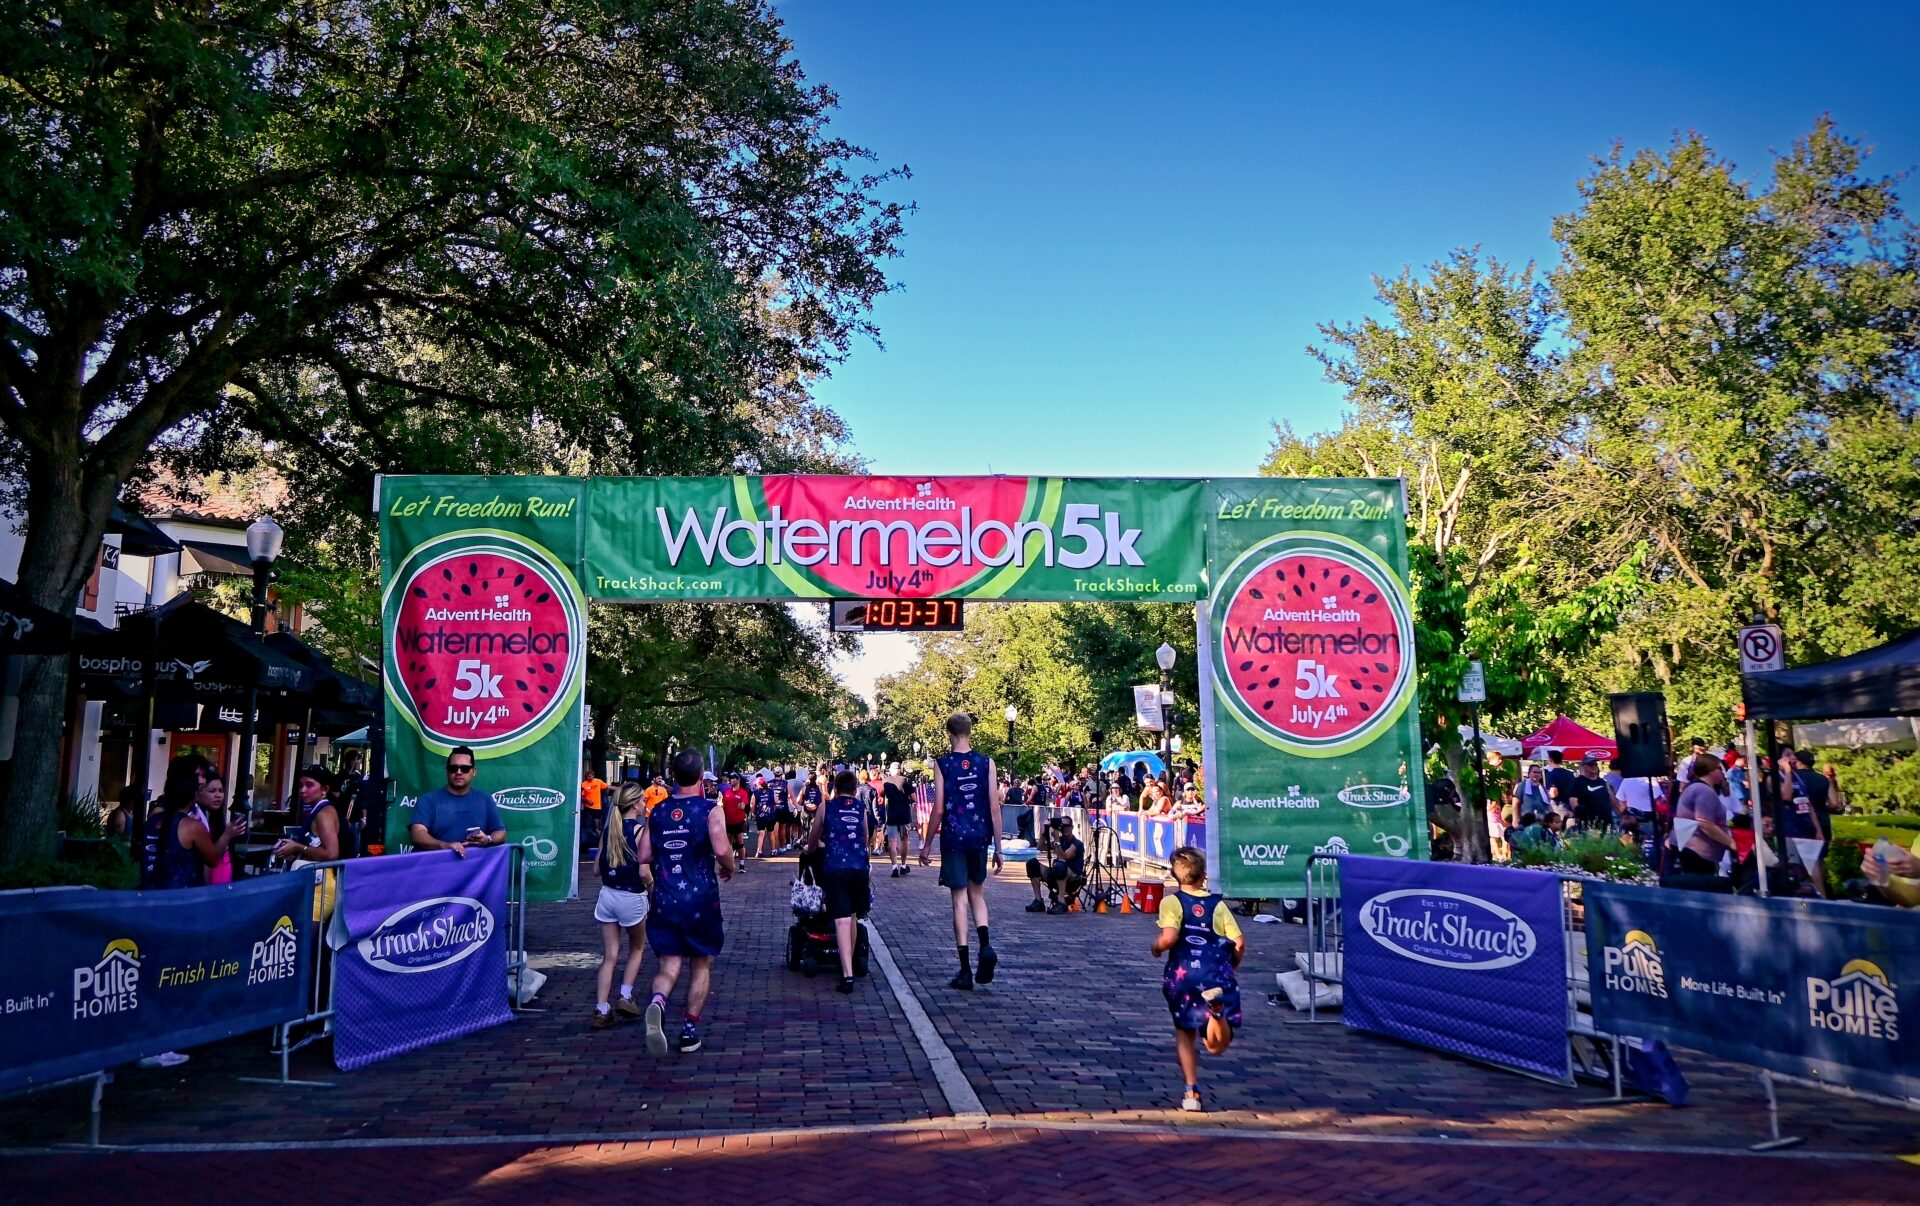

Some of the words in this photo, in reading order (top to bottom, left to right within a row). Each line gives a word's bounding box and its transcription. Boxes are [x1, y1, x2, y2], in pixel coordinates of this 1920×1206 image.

[390, 495, 431, 517] Let
[433, 495, 522, 518] Freedom
[525, 496, 576, 518] Run!
[1218, 497, 1258, 520] Let
[1260, 497, 1344, 520] Freedom
[1348, 499, 1391, 520] Run!
[597, 576, 722, 591] TrackShack.com
[865, 570, 906, 594] July
[906, 570, 934, 589] 4th
[1074, 578, 1198, 594] TrackShack.com
[398, 626, 570, 655] Watermelon
[1225, 626, 1400, 655] Watermelon
[452, 659, 504, 700] 5k
[1295, 659, 1341, 700] 5k
[443, 705, 483, 730] July
[484, 705, 510, 724] 4th
[1289, 704, 1324, 729] July
[1324, 705, 1348, 723] 4th
[495, 793, 527, 804] Track
[527, 792, 562, 804] Shack
[1344, 791, 1372, 801] Track
[1238, 844, 1289, 859] WOW!
[1438, 900, 1460, 911] 1977
[371, 920, 432, 959] Track
[432, 909, 488, 949] Shack
[1371, 904, 1439, 943] Track
[1440, 913, 1528, 958] Shack
[250, 935, 297, 970] Pulte
[1603, 946, 1664, 983] Pulte
[73, 960, 140, 1001] Pulte
[159, 961, 206, 989] Finish
[210, 959, 240, 980] Line
[247, 962, 295, 987] HOMES
[1605, 974, 1669, 999] HOMES
[1680, 976, 1711, 993] More
[1712, 981, 1735, 997] Life
[1736, 984, 1766, 1002] Built
[1806, 977, 1900, 1023] Pulte
[5, 994, 35, 1014] Built
[73, 991, 138, 1020] HOMES
[1809, 1008, 1900, 1042] HOMES
